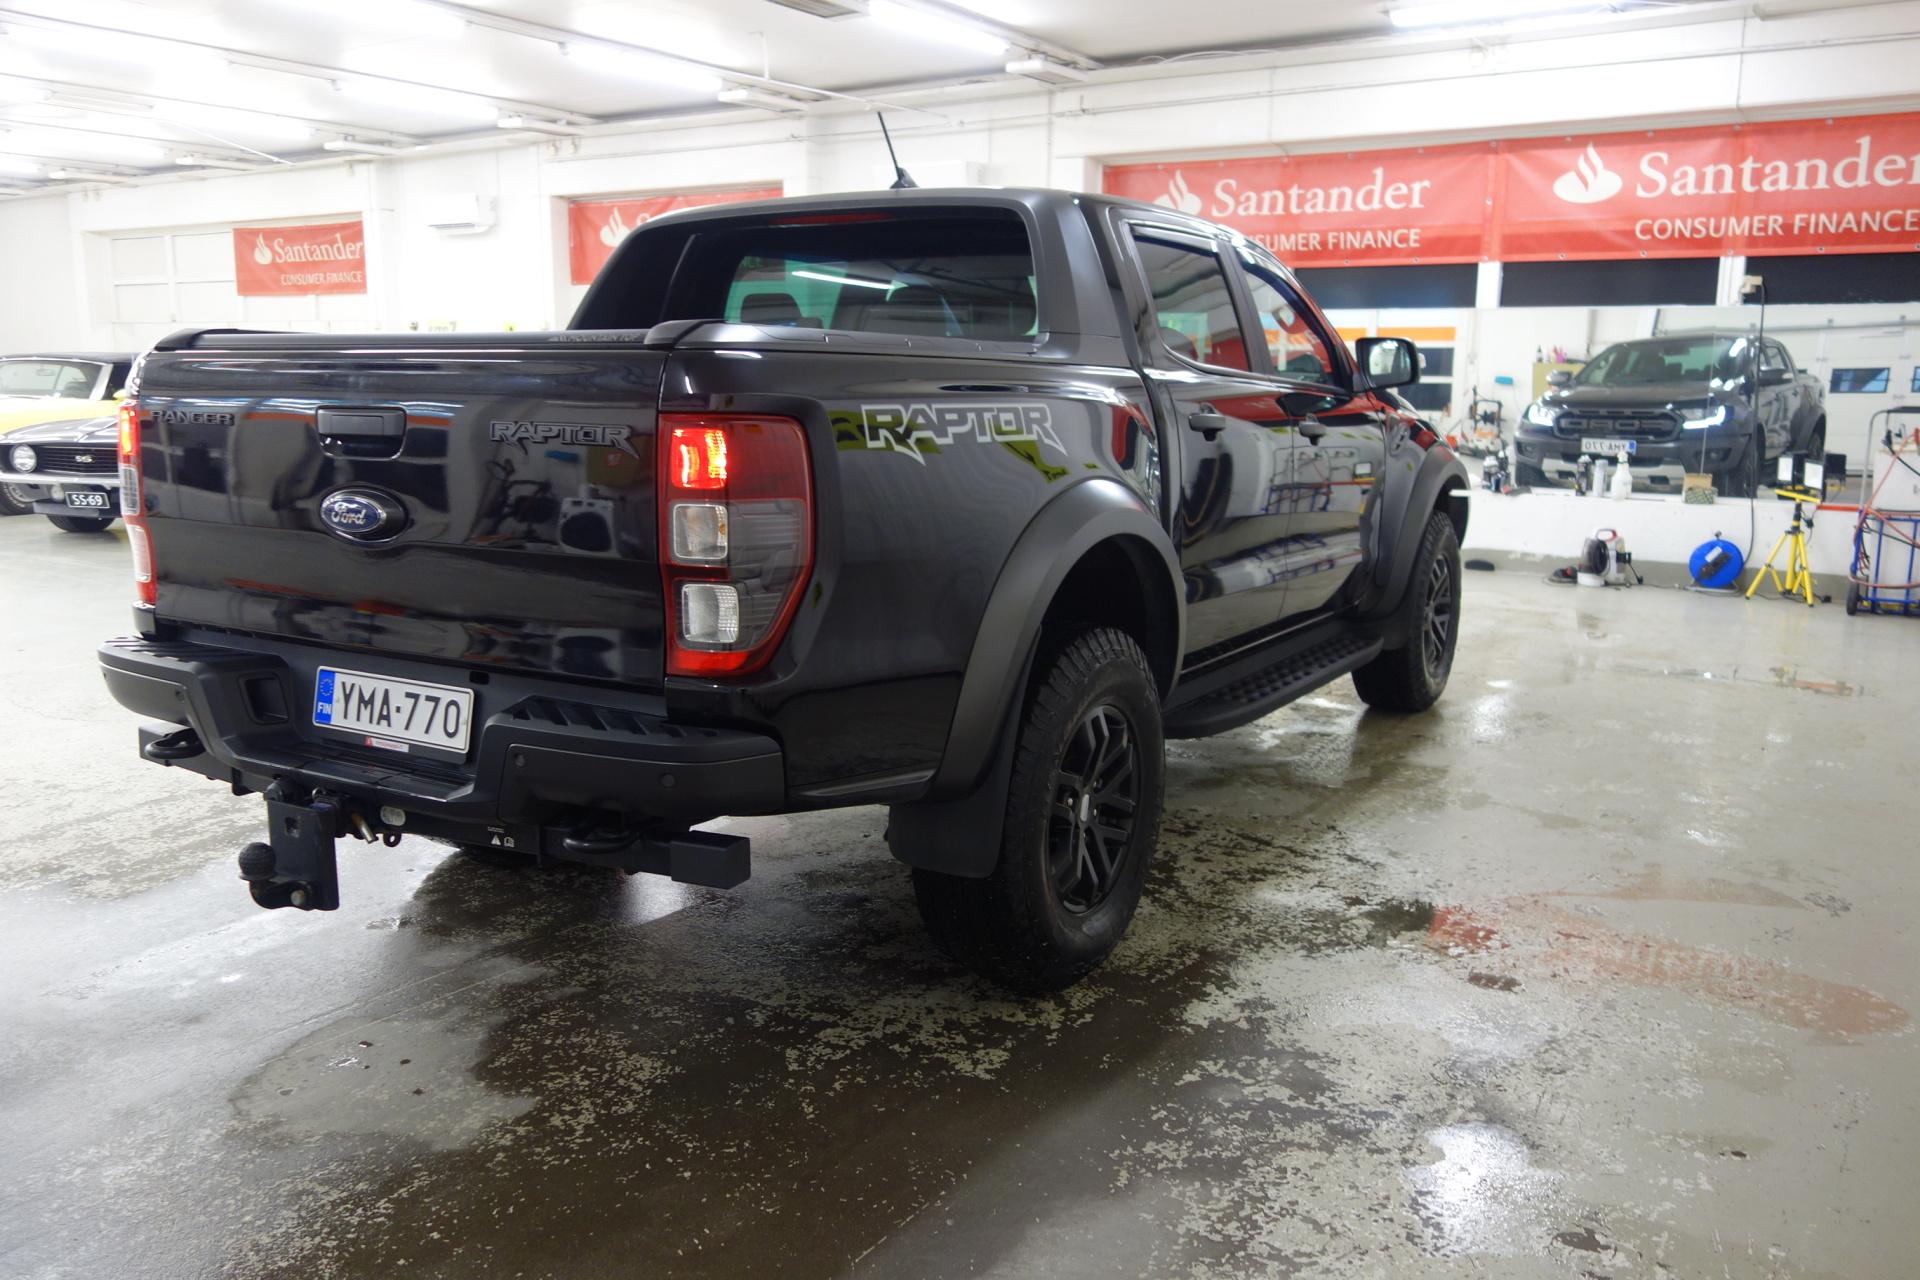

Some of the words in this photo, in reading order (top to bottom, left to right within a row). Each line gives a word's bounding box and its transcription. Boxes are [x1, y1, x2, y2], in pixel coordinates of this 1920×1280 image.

[1635, 135, 1920, 198] Santander
[1211, 166, 1431, 217] Santander
[1327, 228, 1421, 250] FINANCE
[1635, 215, 1783, 240] CONSUMER
[1793, 209, 1920, 235] FINANCE
[273, 232, 363, 263] Santander
[281, 272, 325, 286] CONSUMER
[326, 270, 362, 284] FINANCE
[150, 410, 236, 426] RANGER
[490, 421, 640, 459] RAPTOR
[861, 403, 1068, 466] RAPTOR
[72, 494, 103, 506] SS-69
[331, 501, 367, 525] Ford
[317, 702, 332, 714] FIN
[341, 681, 461, 739] YMA-770
